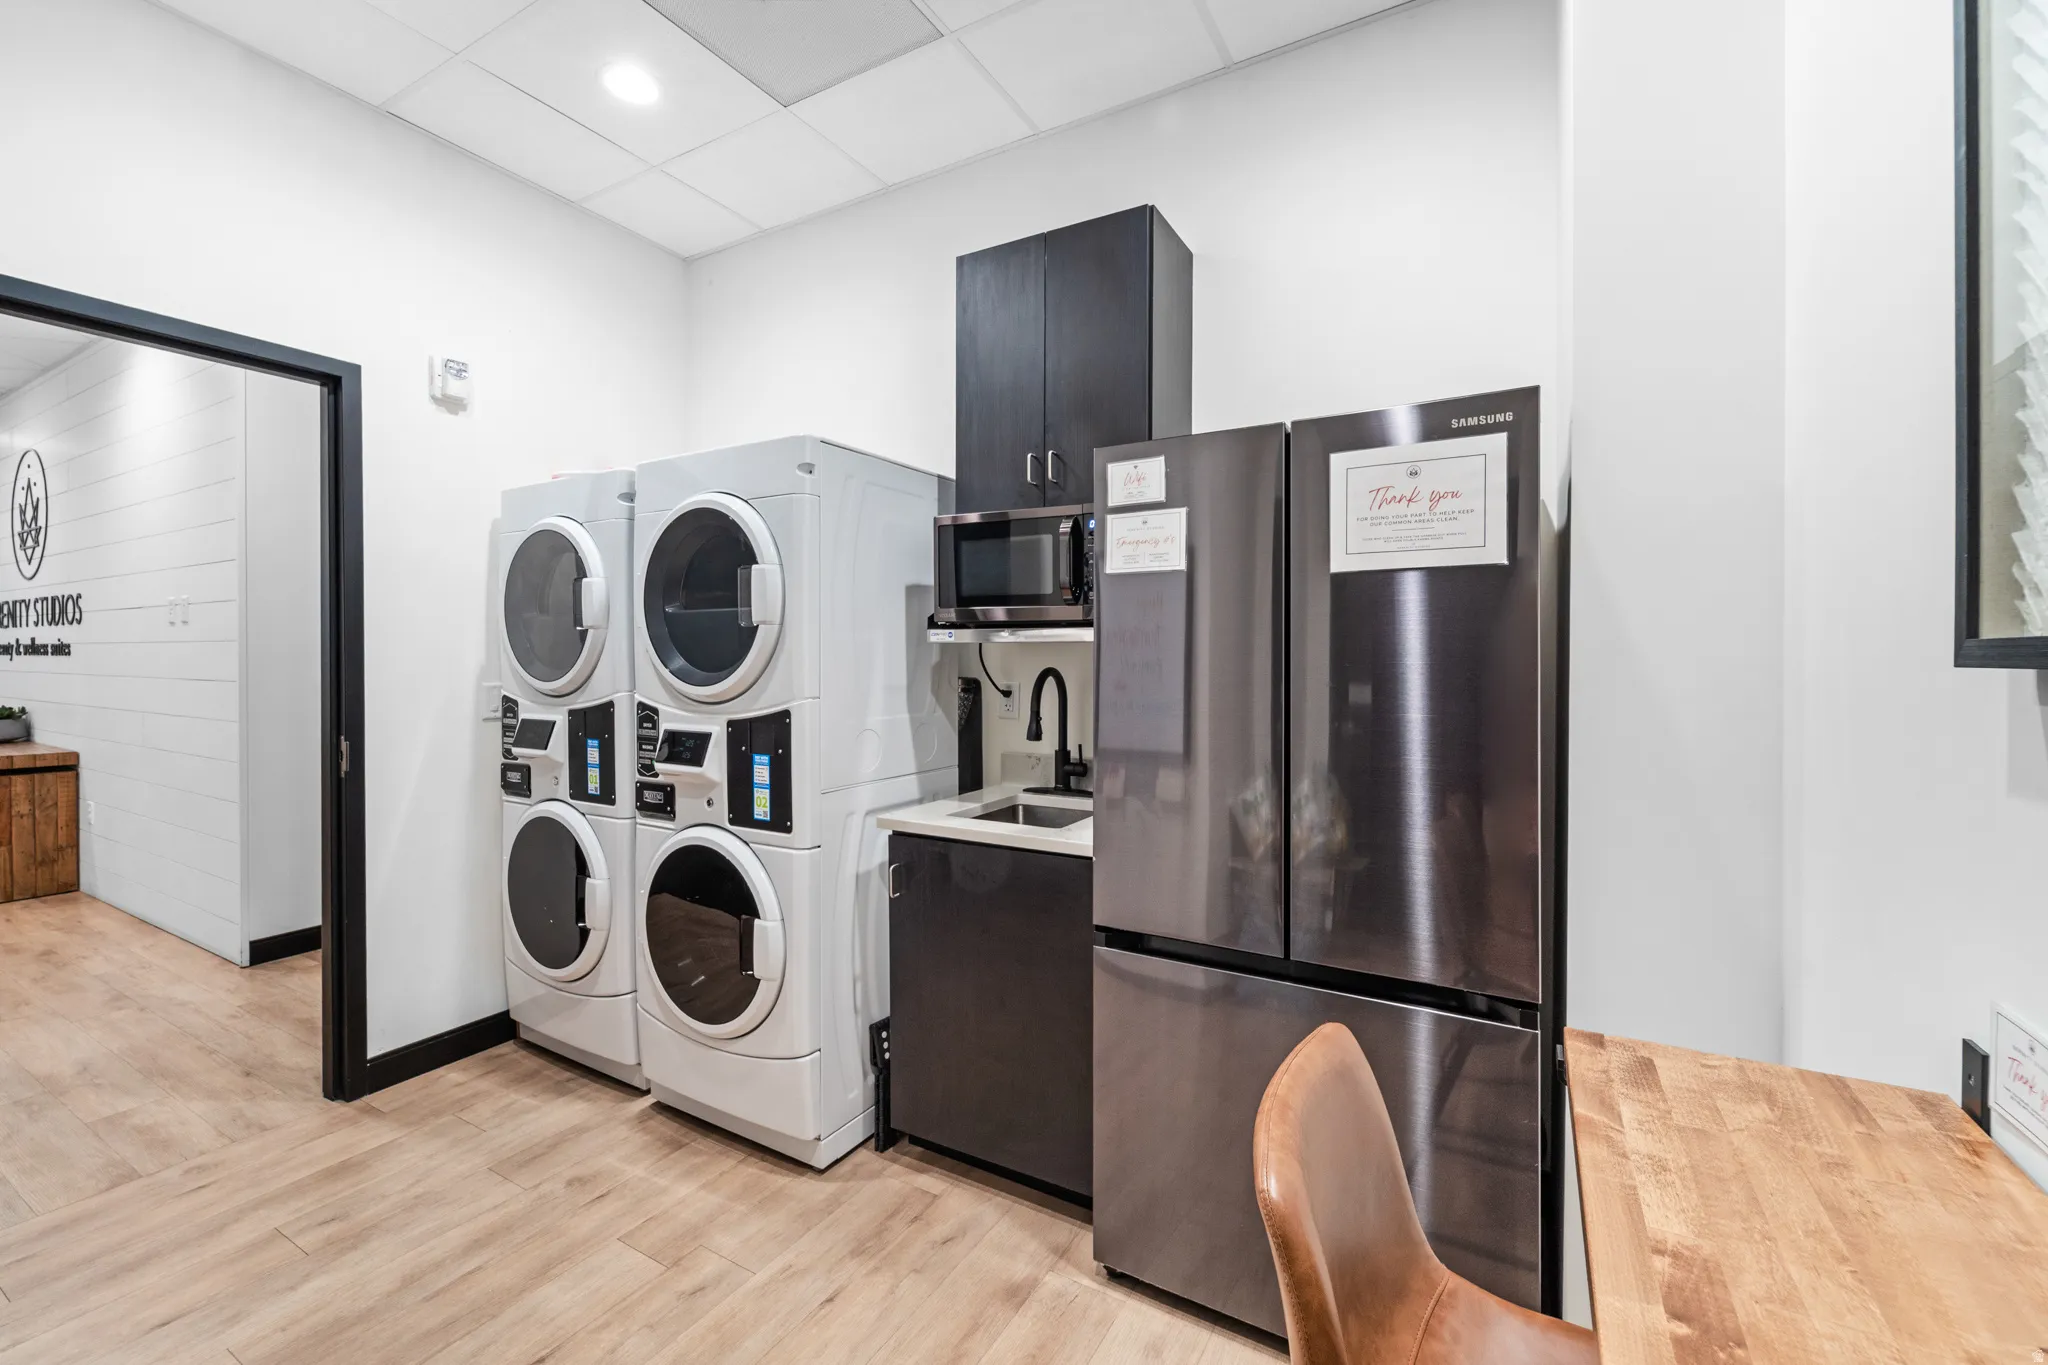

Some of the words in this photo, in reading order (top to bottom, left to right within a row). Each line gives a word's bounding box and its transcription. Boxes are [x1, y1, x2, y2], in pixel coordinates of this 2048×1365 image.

[1451, 411, 1514, 428] SAMSUNG
[1368, 485, 1424, 511] Thank
[1429, 488, 1463, 511] you
[33, 592, 82, 628] STUDIOS
[15, 637, 22, 656] &
[22, 636, 49, 656] wellness
[50, 638, 71, 656] suites
[589, 774, 598, 785] 01
[755, 796, 768, 808] 02
